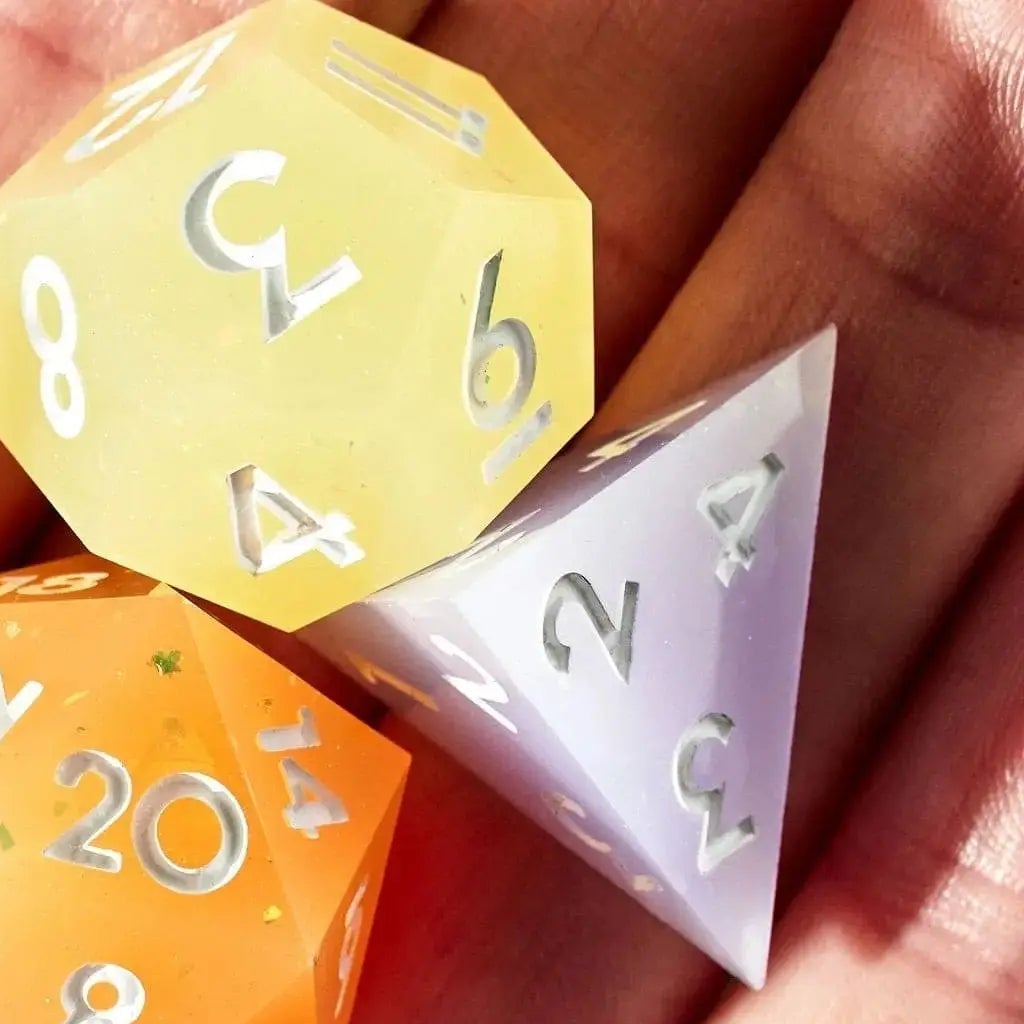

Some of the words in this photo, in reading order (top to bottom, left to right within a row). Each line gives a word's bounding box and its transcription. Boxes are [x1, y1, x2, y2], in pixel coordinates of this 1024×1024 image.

[184, 149, 363, 343] 3
[21, 255, 85, 440] 8
[226, 463, 366, 577] 4
[697, 452, 786, 587] 4
[542, 571, 640, 684] 2
[43, 749, 249, 895] 20
[256, 706, 350, 839] 14
[672, 711, 757, 877] 3
